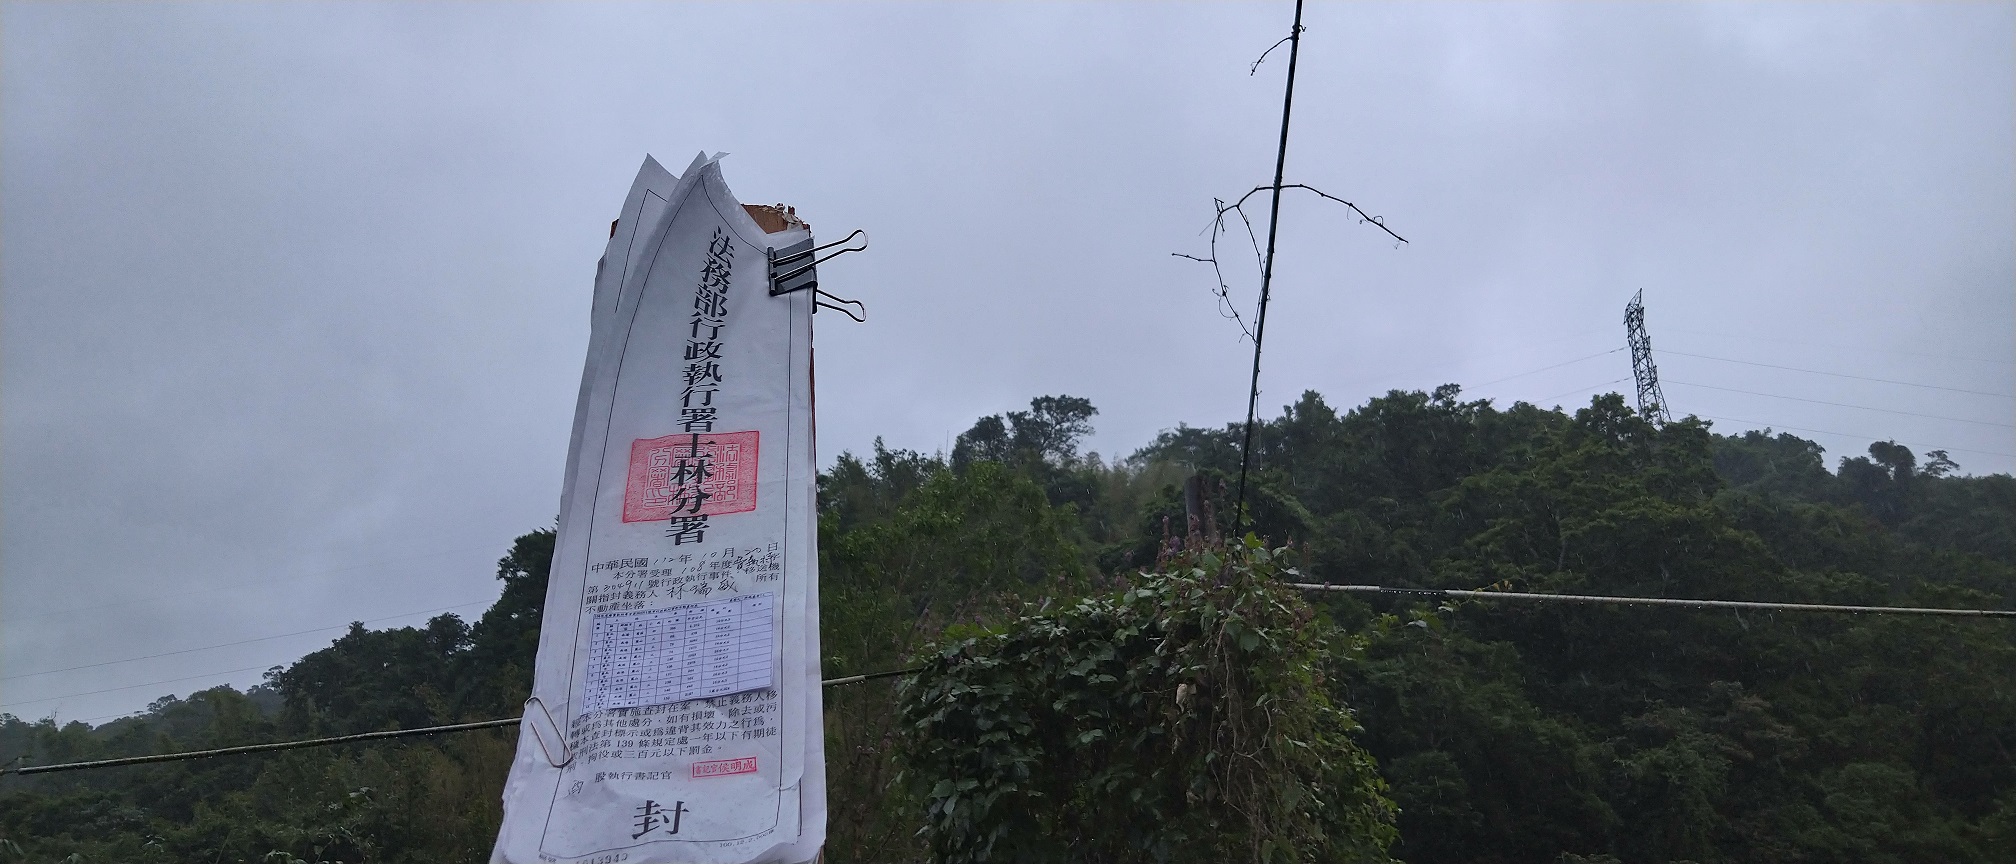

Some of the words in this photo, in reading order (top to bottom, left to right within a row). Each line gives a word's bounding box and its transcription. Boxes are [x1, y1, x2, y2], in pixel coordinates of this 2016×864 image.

[664, 226, 735, 546] 法務部行政執行署士林分署
[592, 558, 648, 574] 中華民國
[680, 554, 692, 565] 年
[723, 547, 734, 558] 月
[768, 542, 778, 552] 日
[613, 568, 672, 580] 本分署受理
[588, 585, 599, 595] 第
[631, 800, 690, 840] 封
